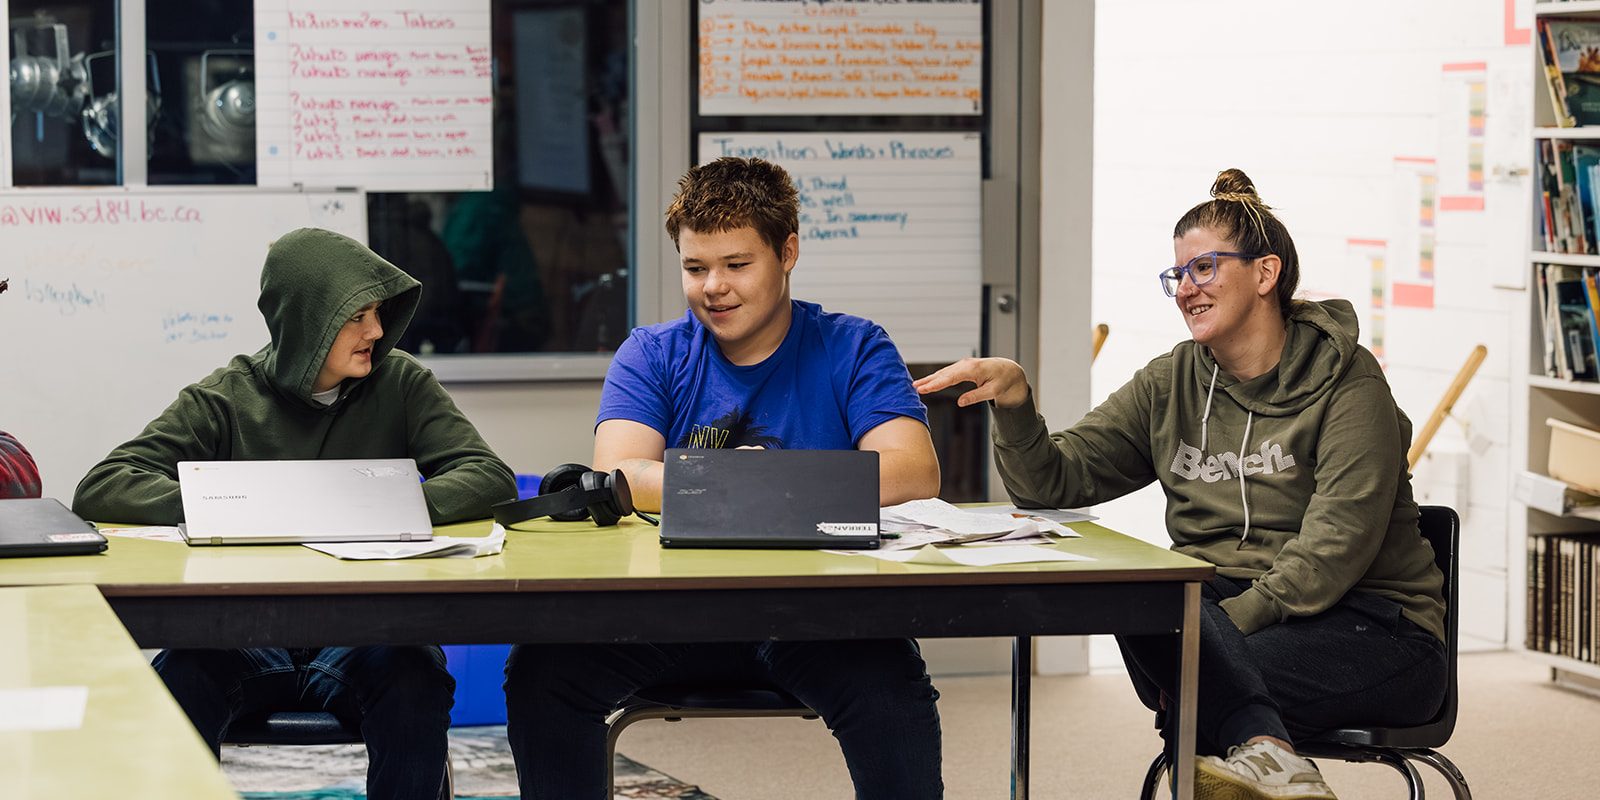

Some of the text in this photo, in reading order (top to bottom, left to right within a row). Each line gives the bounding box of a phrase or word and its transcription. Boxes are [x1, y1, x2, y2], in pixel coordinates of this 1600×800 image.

[712, 138, 818, 162] Transition
[825, 138, 875, 160] Words
[890, 139, 954, 160] Phrases
